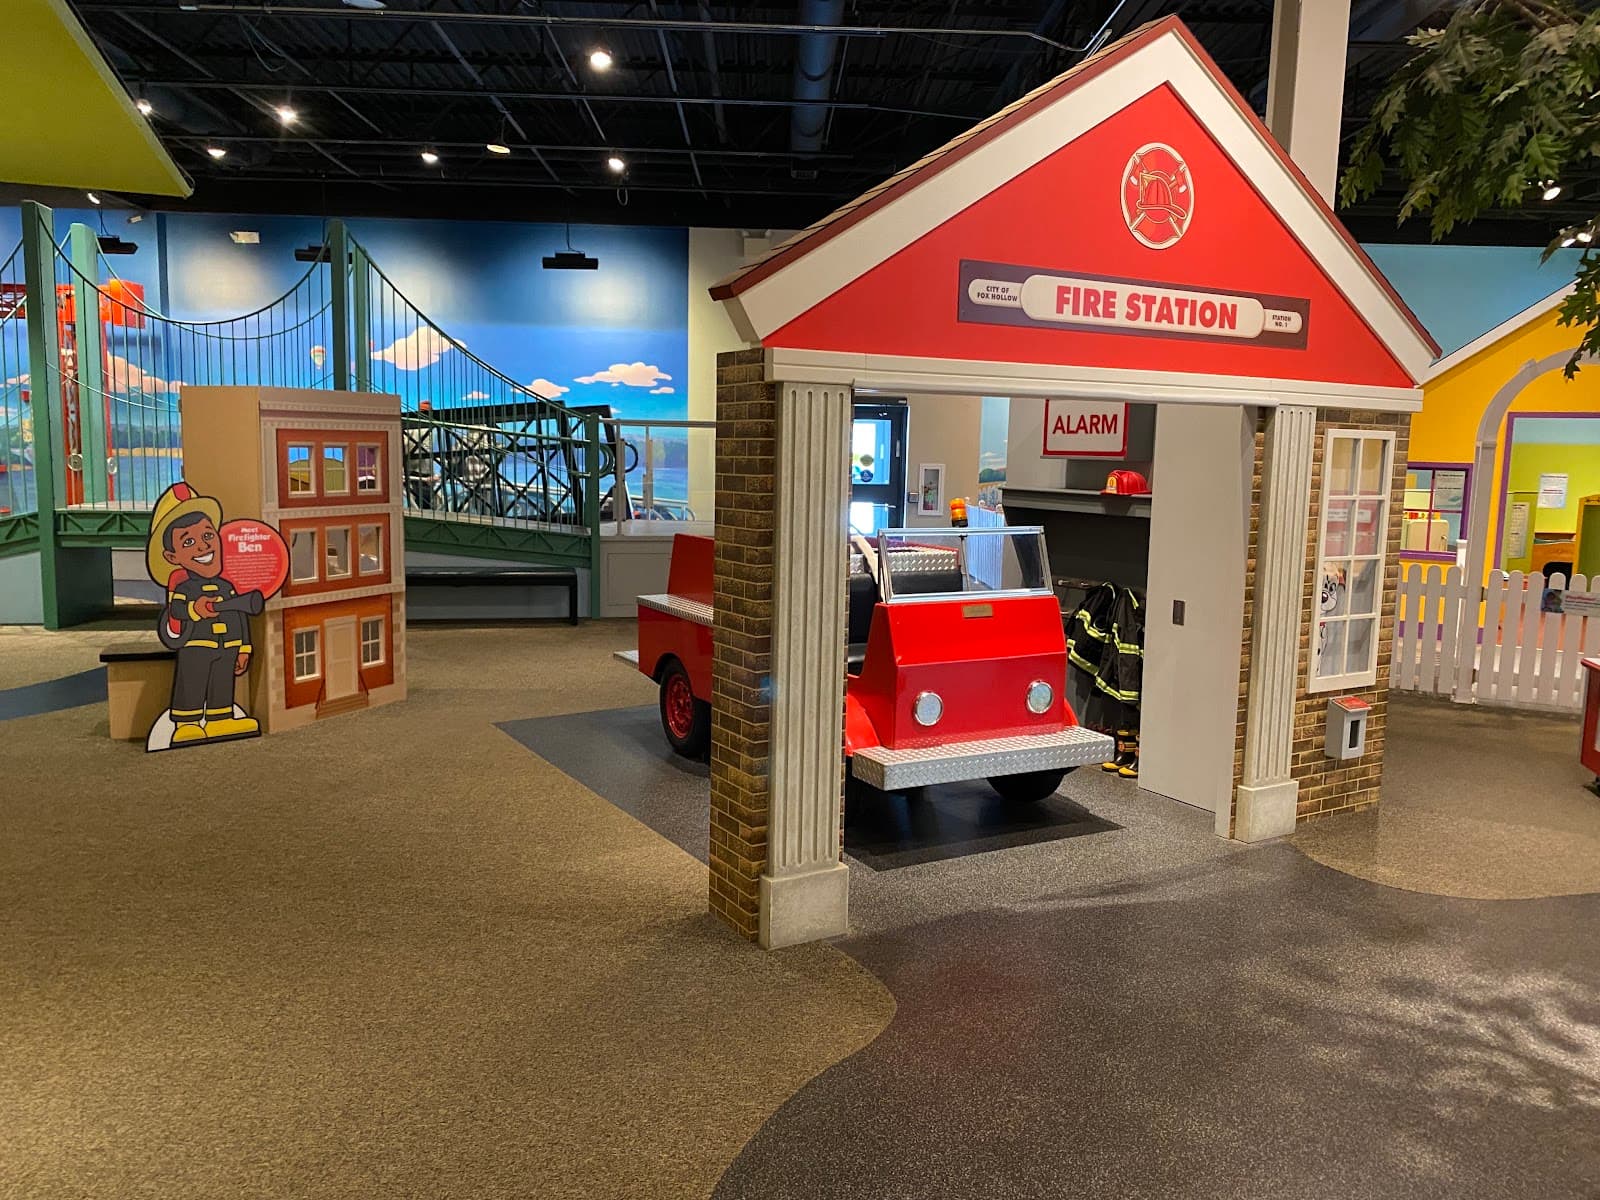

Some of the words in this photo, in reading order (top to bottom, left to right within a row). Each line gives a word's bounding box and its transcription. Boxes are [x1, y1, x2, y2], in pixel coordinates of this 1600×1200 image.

[977, 291, 990, 299] FOX
[991, 293, 1018, 302] HOLLOW
[1056, 285, 1117, 318] FIRE
[1125, 292, 1238, 330] STATION
[1272, 314, 1291, 322] STATION
[1052, 413, 1118, 435] ALARM
[228, 533, 272, 542] Firefighter
[238, 542, 263, 553] Ben
